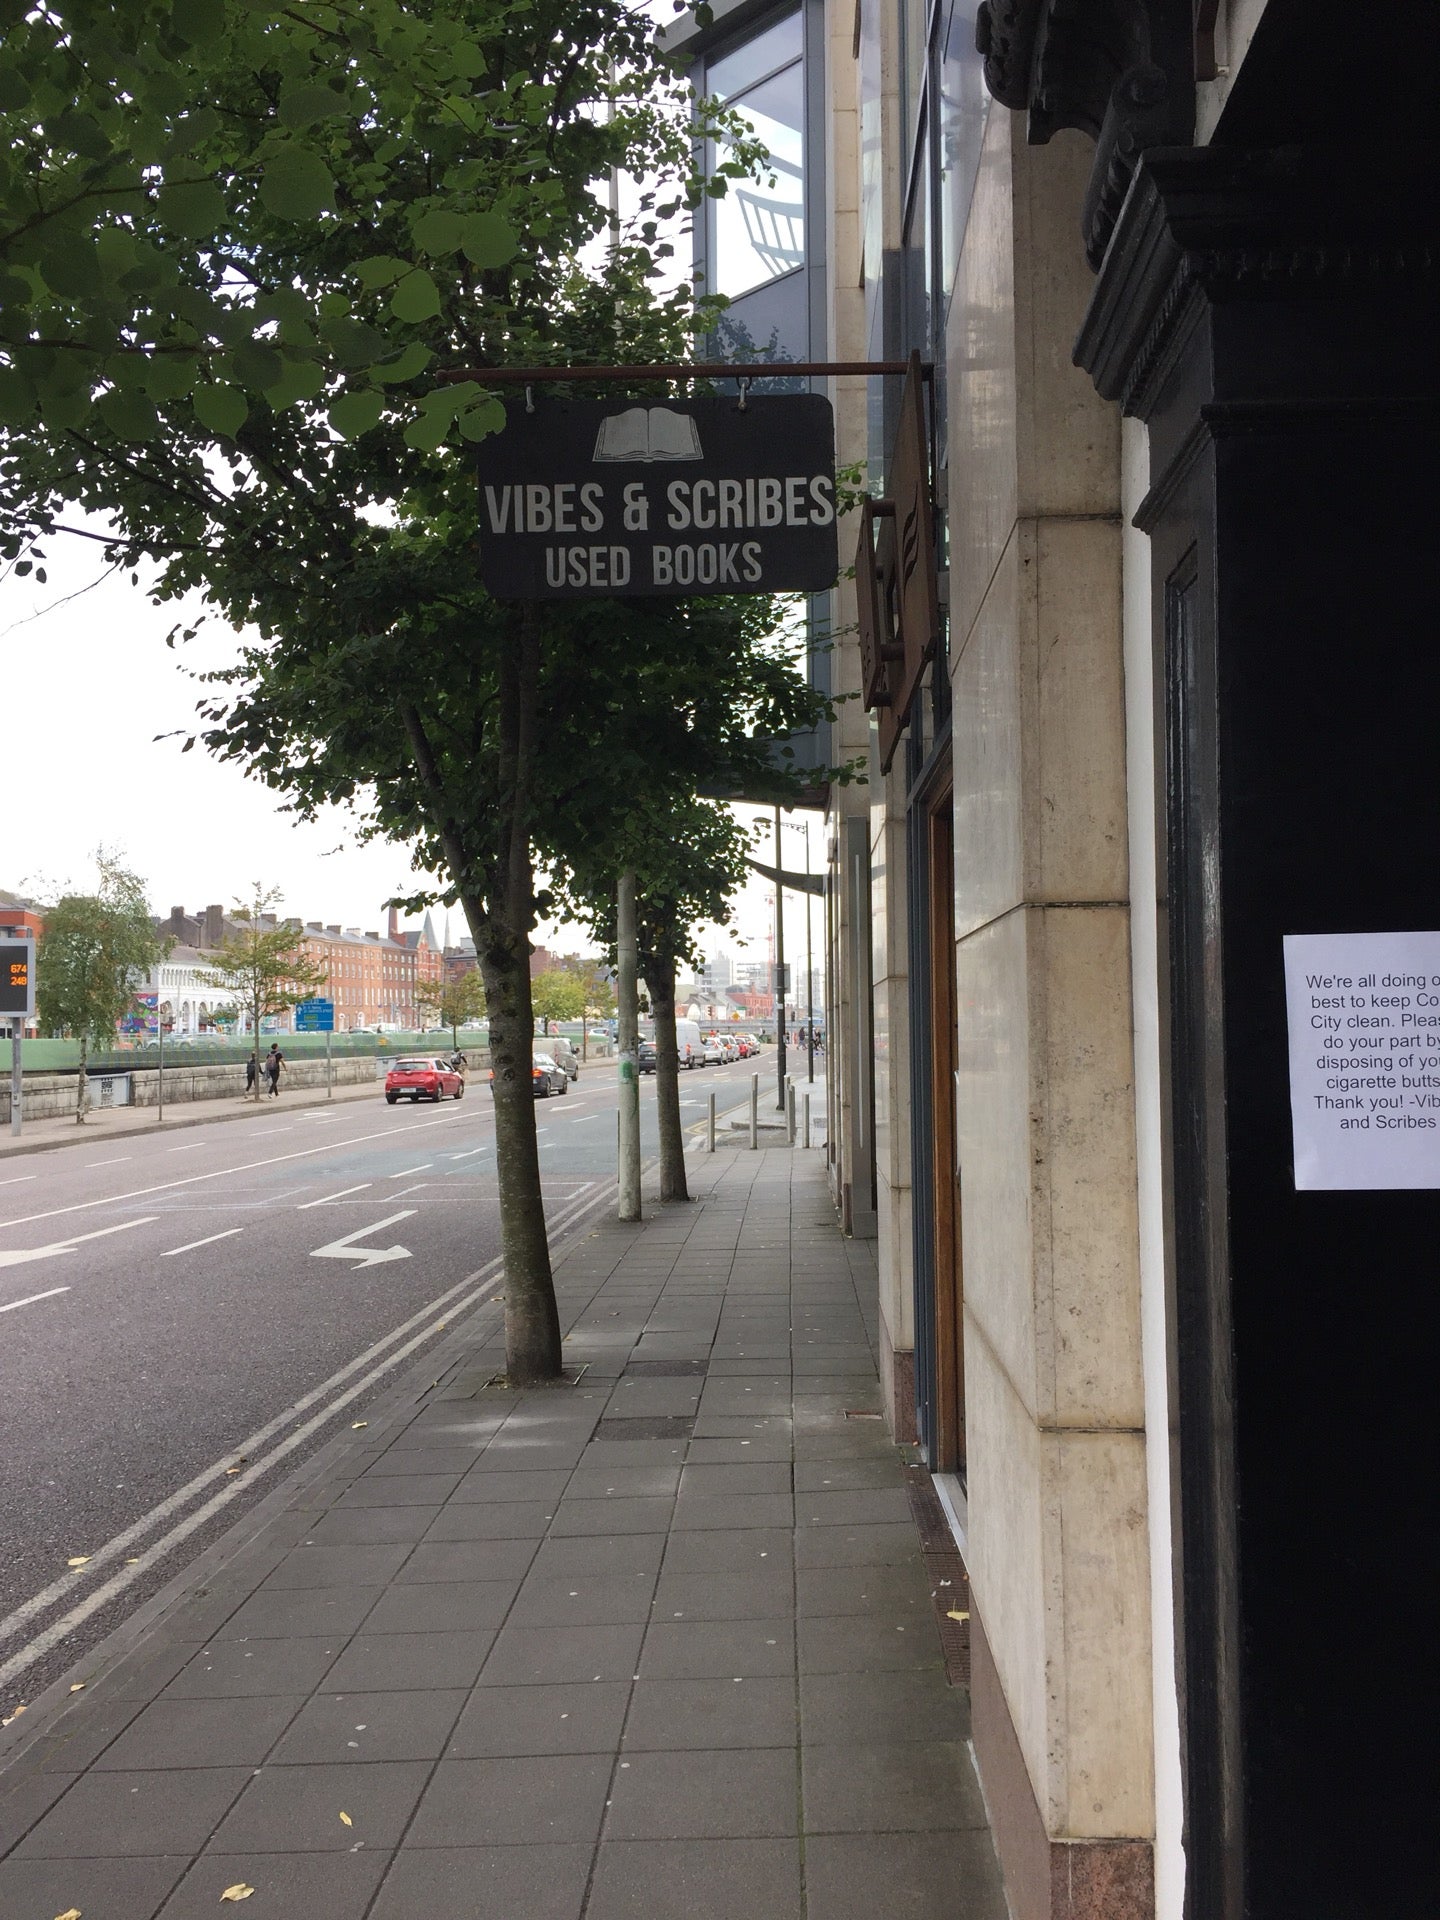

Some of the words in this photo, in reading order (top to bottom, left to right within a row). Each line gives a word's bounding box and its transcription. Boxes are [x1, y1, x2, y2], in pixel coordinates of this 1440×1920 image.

[484, 482, 604, 534] VIBES
[623, 482, 649, 531] &
[667, 475, 833, 531] SCRIBES
[546, 545, 631, 588] USED
[652, 541, 762, 586] BOOKS
[10, 964, 27, 973] 674
[1306, 975, 1352, 988] We're
[1358, 974, 1376, 987] all
[1382, 973, 1426, 990] doing
[1311, 995, 1345, 1008] best
[1351, 995, 1366, 1007] to
[1371, 994, 1411, 1010] keep
[1416, 993, 1439, 1007] Co
[1311, 1015, 1341, 1032] City
[1347, 1014, 1395, 1028] clean.
[1401, 1013, 1440, 1027] Plea
[1324, 1035, 1344, 1048] do
[1349, 1037, 1385, 1052] your
[1390, 1034, 1421, 1051] part
[1316, 1055, 1393, 1072] disposing
[1399, 1054, 1414, 1068] of
[1419, 1057, 1440, 1071] yo
[1326, 1075, 1397, 1092] cigarette
[1313, 1095, 1364, 1109] Thank
[1369, 1094, 1403, 1112] you!
[1340, 1115, 1370, 1130] and
[1376, 1115, 1437, 1129] Scribes
